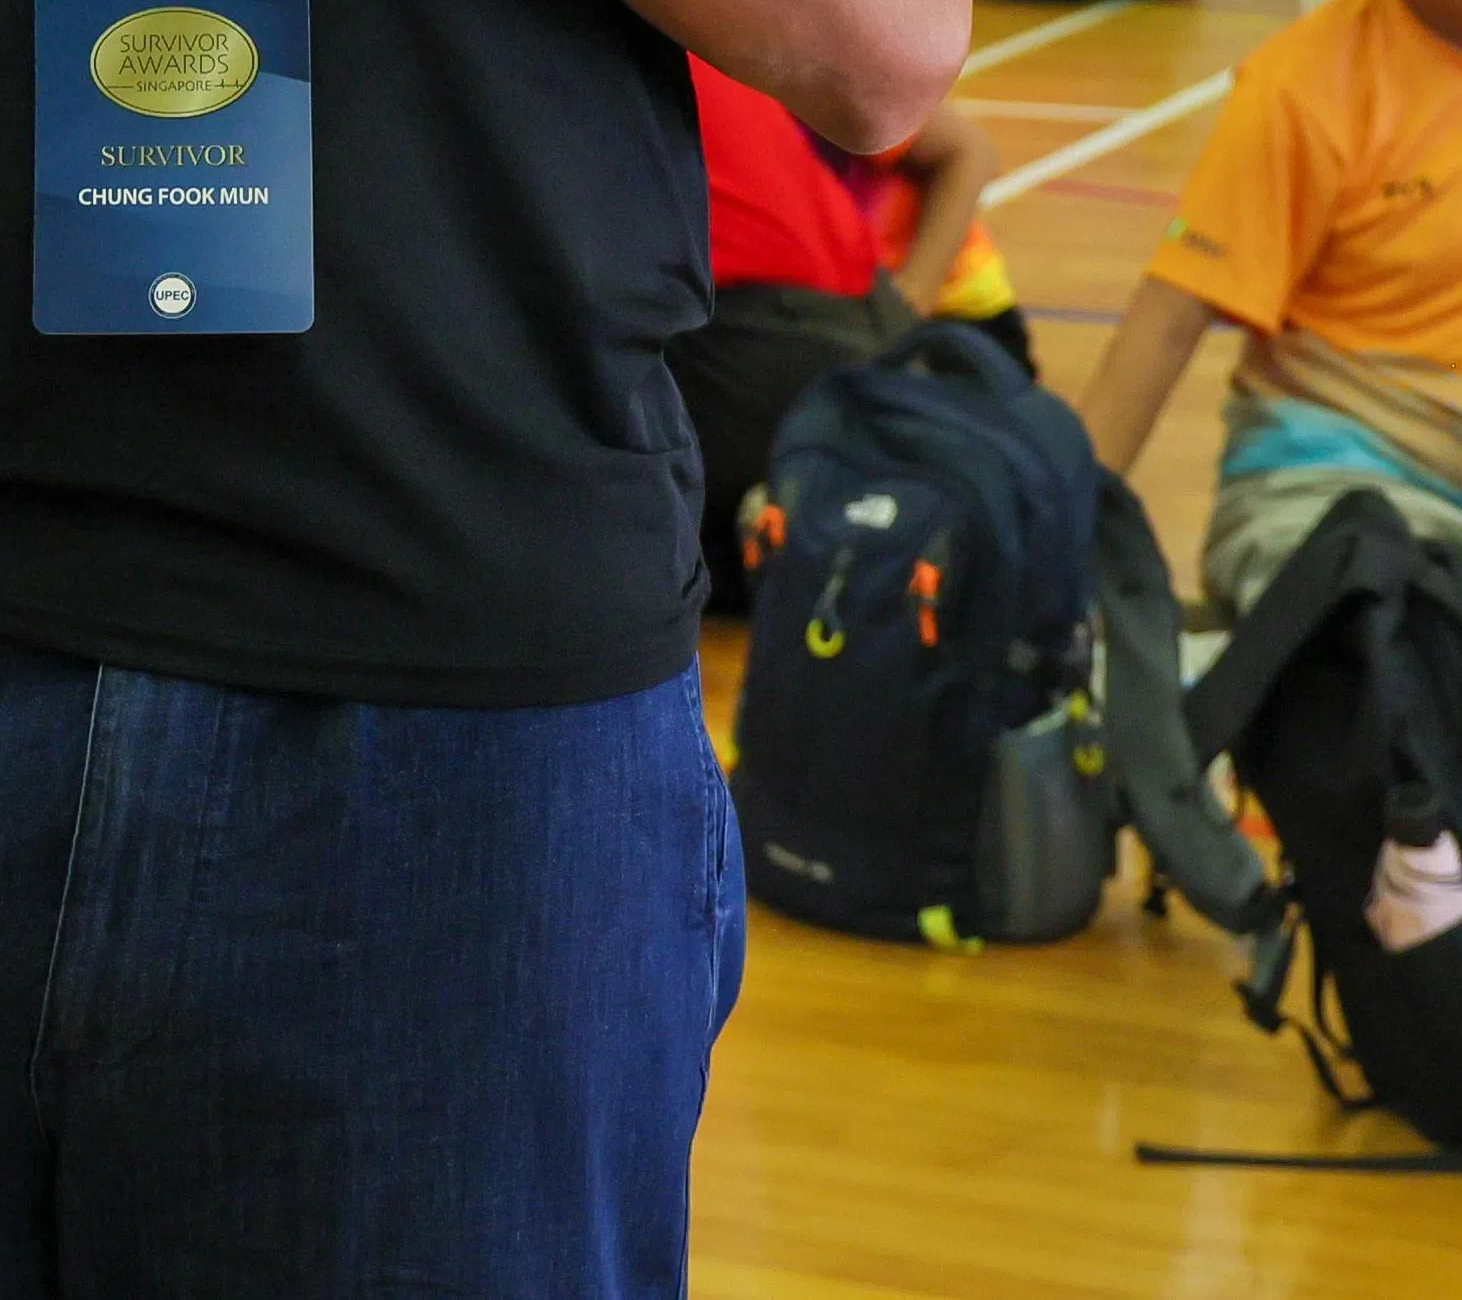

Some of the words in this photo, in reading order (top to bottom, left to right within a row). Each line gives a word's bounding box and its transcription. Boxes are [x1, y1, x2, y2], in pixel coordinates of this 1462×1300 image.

[119, 34, 229, 52] SURVIVOR
[118, 54, 229, 75] AWARDS
[136, 80, 212, 92] SINGAPORE
[100, 145, 245, 167] SURVIVOR
[78, 188, 153, 206] CHUNG
[158, 188, 215, 206] FOOK
[220, 187, 269, 205] MUN
[156, 289, 189, 301] UPEC
